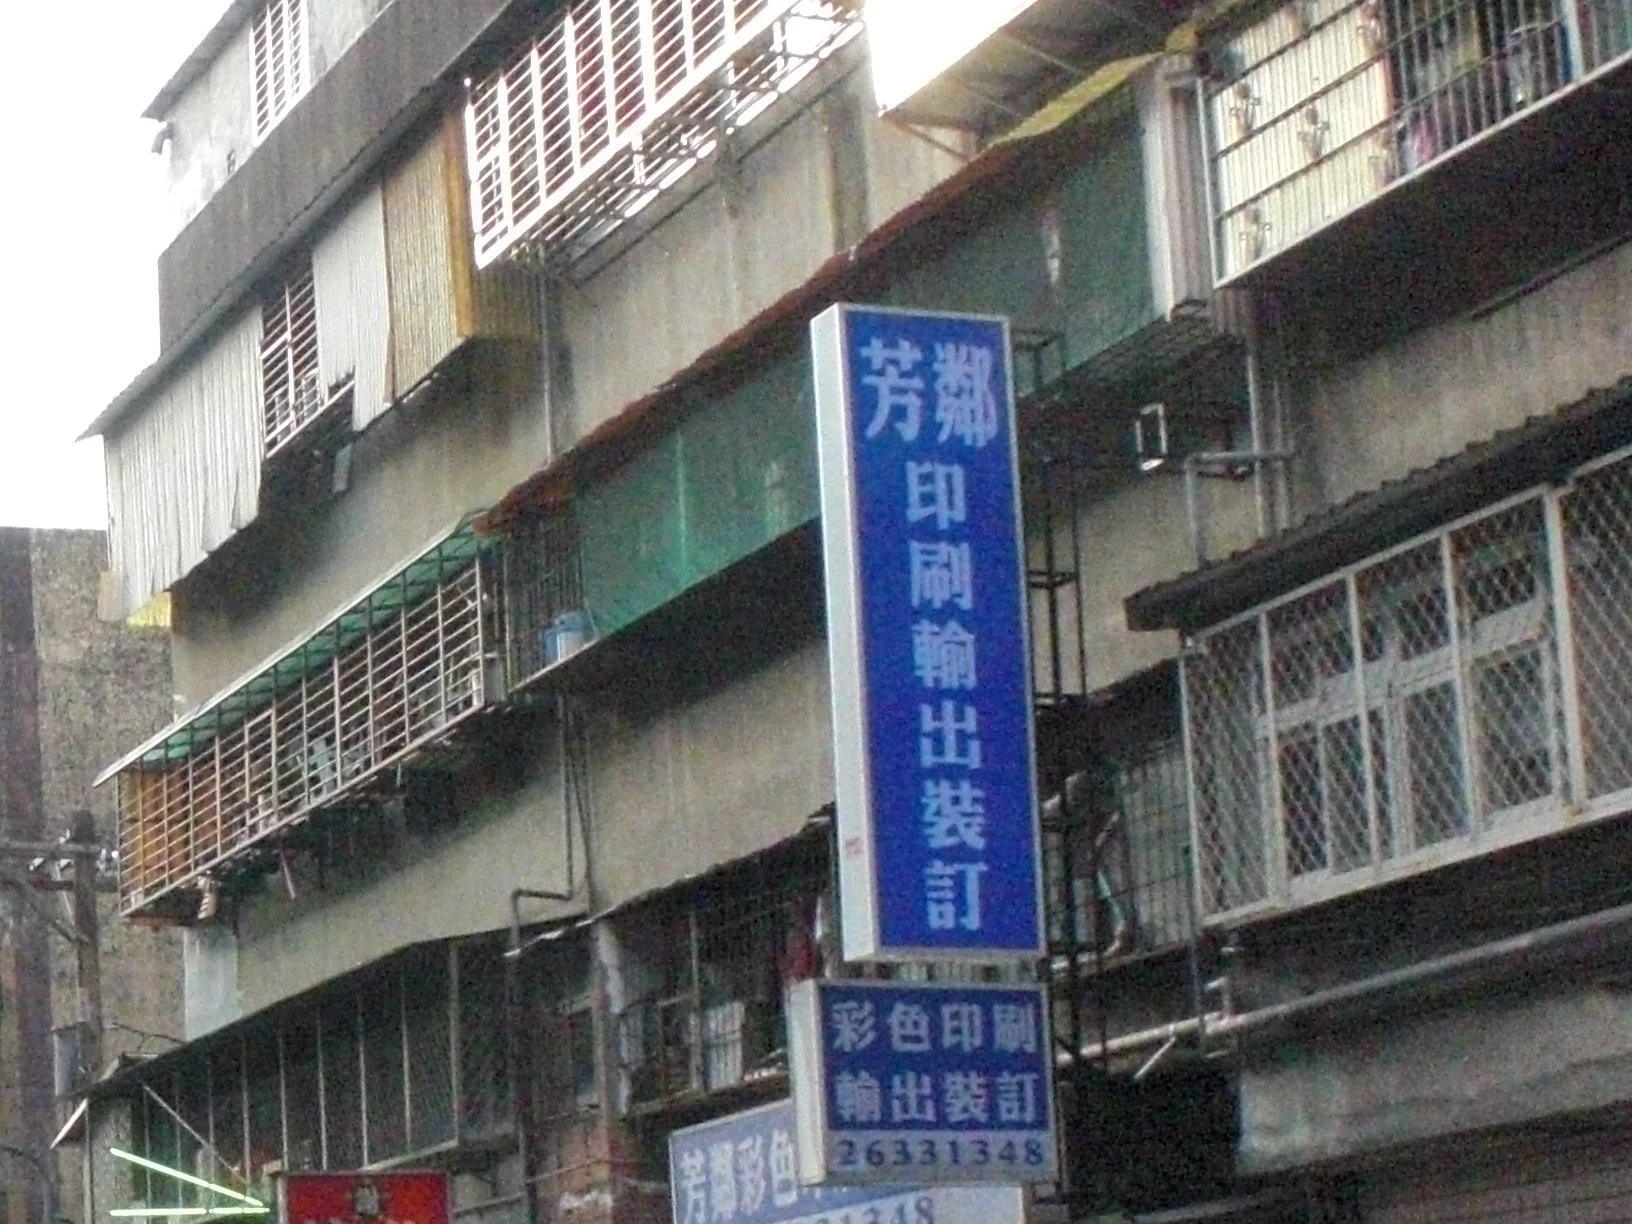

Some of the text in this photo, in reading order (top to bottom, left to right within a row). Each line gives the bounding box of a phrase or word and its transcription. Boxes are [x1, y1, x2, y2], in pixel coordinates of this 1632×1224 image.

[904, 459, 989, 932] 印刷輸出裝訂
[830, 1000, 1039, 1055] 彩色印刷
[834, 1069, 1041, 1125] 輸出裝訂
[835, 1139, 1045, 1168] 26331348
